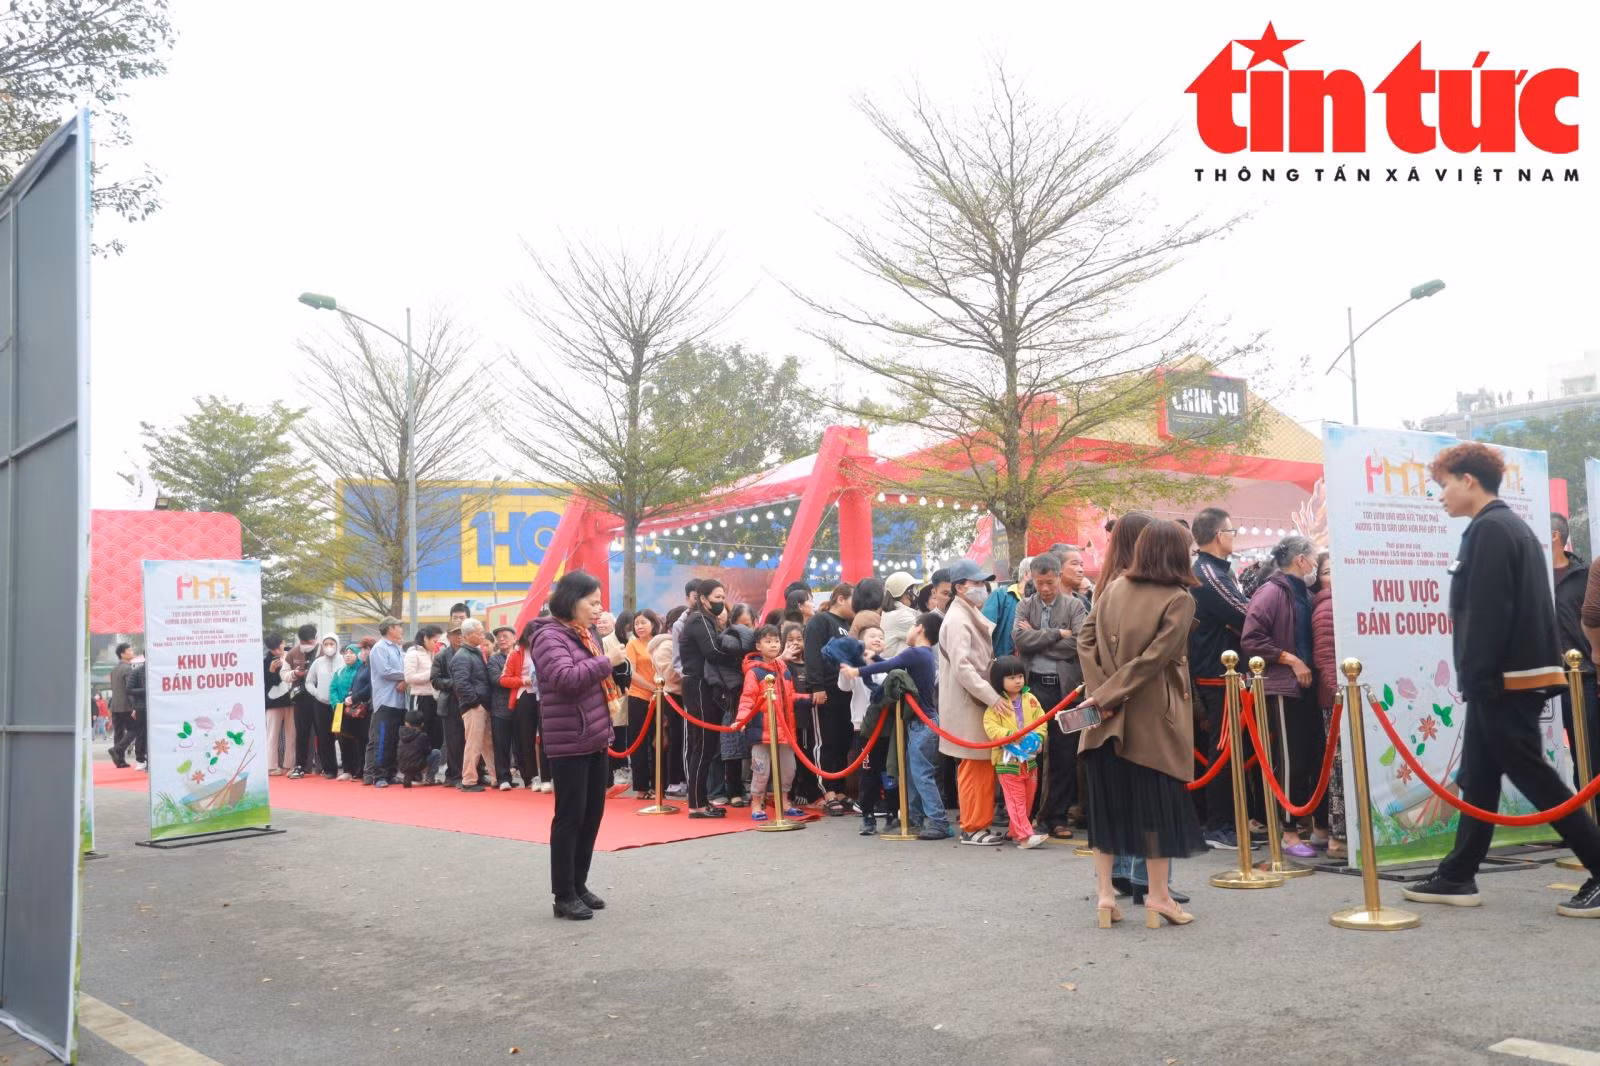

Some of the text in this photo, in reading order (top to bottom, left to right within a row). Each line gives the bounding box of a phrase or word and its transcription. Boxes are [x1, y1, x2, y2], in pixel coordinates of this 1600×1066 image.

[1372, 578, 1439, 607] KHU VỰC
[1357, 607, 1390, 635] BÁN
[177, 651, 238, 671] KHU VỰC
[162, 672, 254, 692] BÁN COUPON
